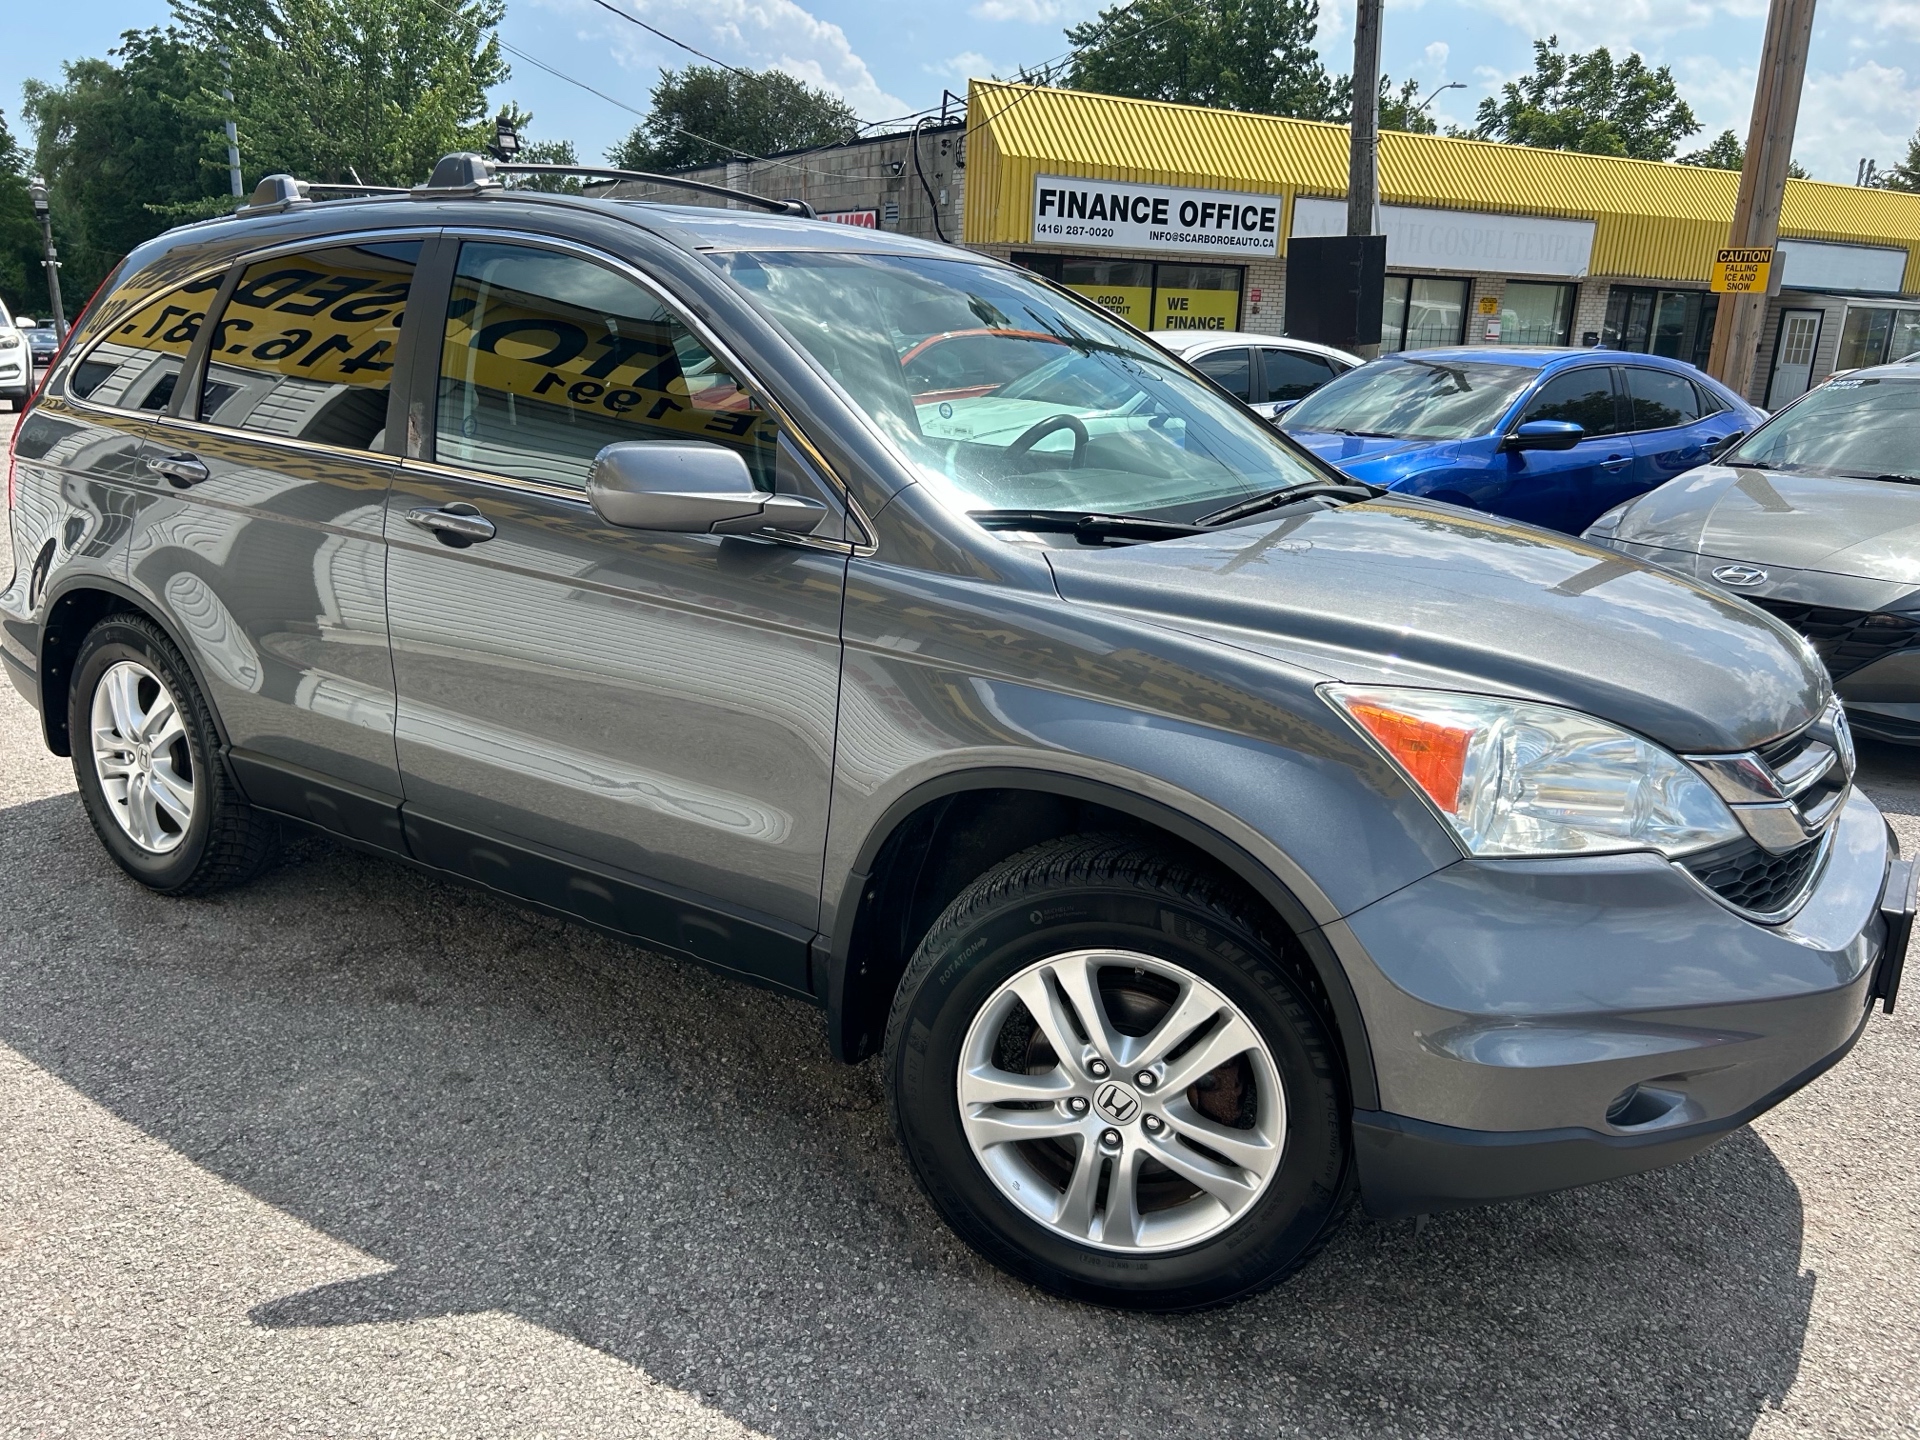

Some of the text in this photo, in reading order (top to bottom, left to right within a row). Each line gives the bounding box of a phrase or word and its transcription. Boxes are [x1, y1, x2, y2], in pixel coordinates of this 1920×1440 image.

[1038, 188, 1277, 233] FINANCE OFFICE
[1037, 223, 1114, 238] (416) 287-0020
[1149, 230, 1275, 249] INFO@SCARBOROEAUTO.CA
[1428, 225, 1508, 260] GOSPEL
[1512, 231, 1589, 264] TEMPLE
[1719, 250, 1770, 262] CAUTION
[1725, 264, 1758, 272] FALLING
[1724, 273, 1756, 282] ICE AND
[1726, 282, 1751, 291] SNOW
[1097, 295, 1125, 305] GOOD
[1167, 297, 1189, 311] WE
[1165, 315, 1226, 330] FINANCE
[938, 945, 979, 986] ROTATION
[1214, 939, 1333, 1070] MICHELIN
